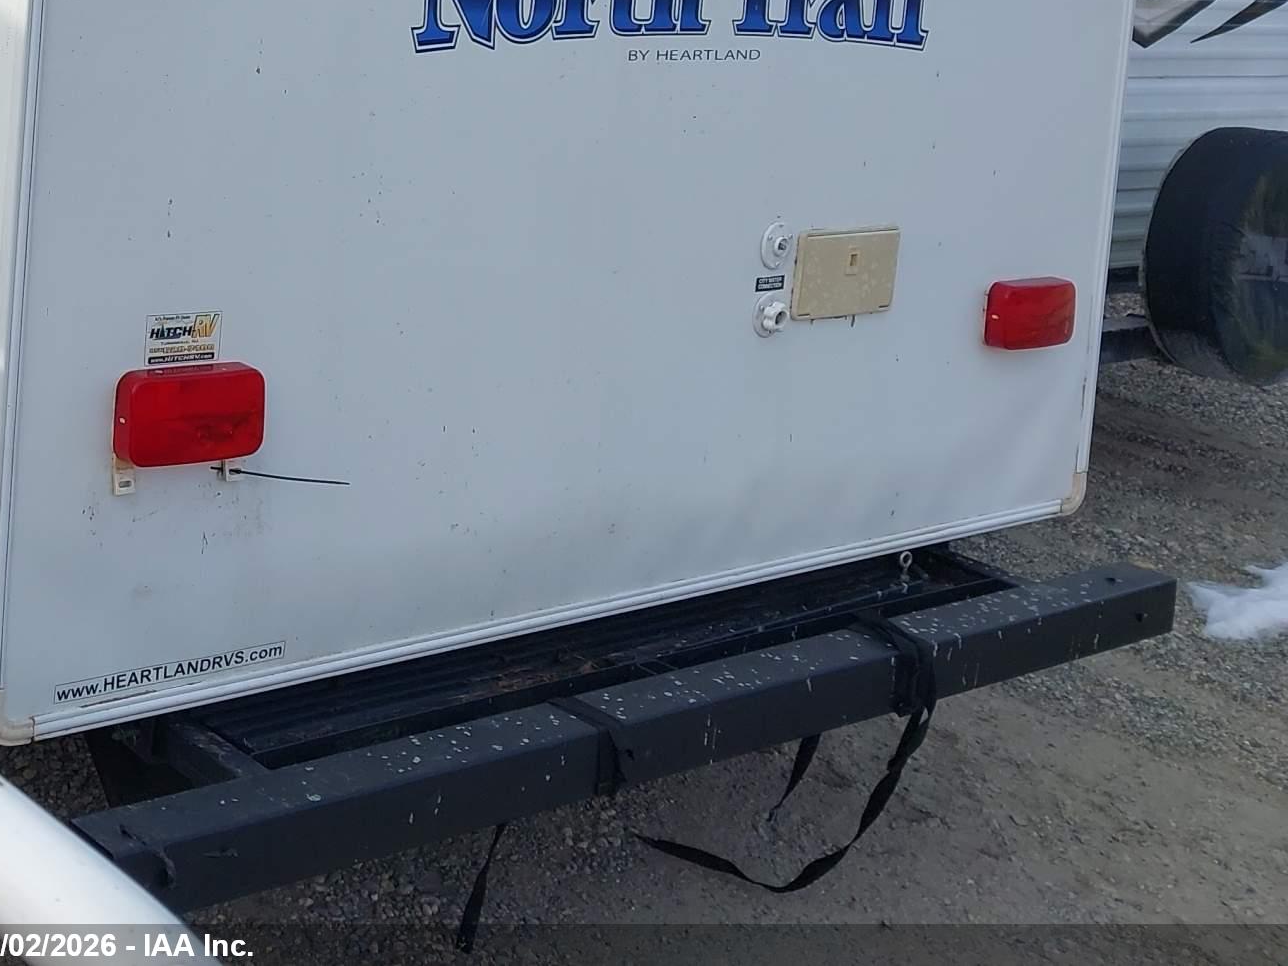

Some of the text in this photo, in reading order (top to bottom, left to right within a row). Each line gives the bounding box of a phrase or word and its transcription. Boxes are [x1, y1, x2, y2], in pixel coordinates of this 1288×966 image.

[628, 49, 761, 61] BY HEARTLAND
[56, 646, 282, 701] www.HEARTLANDRVS.com
